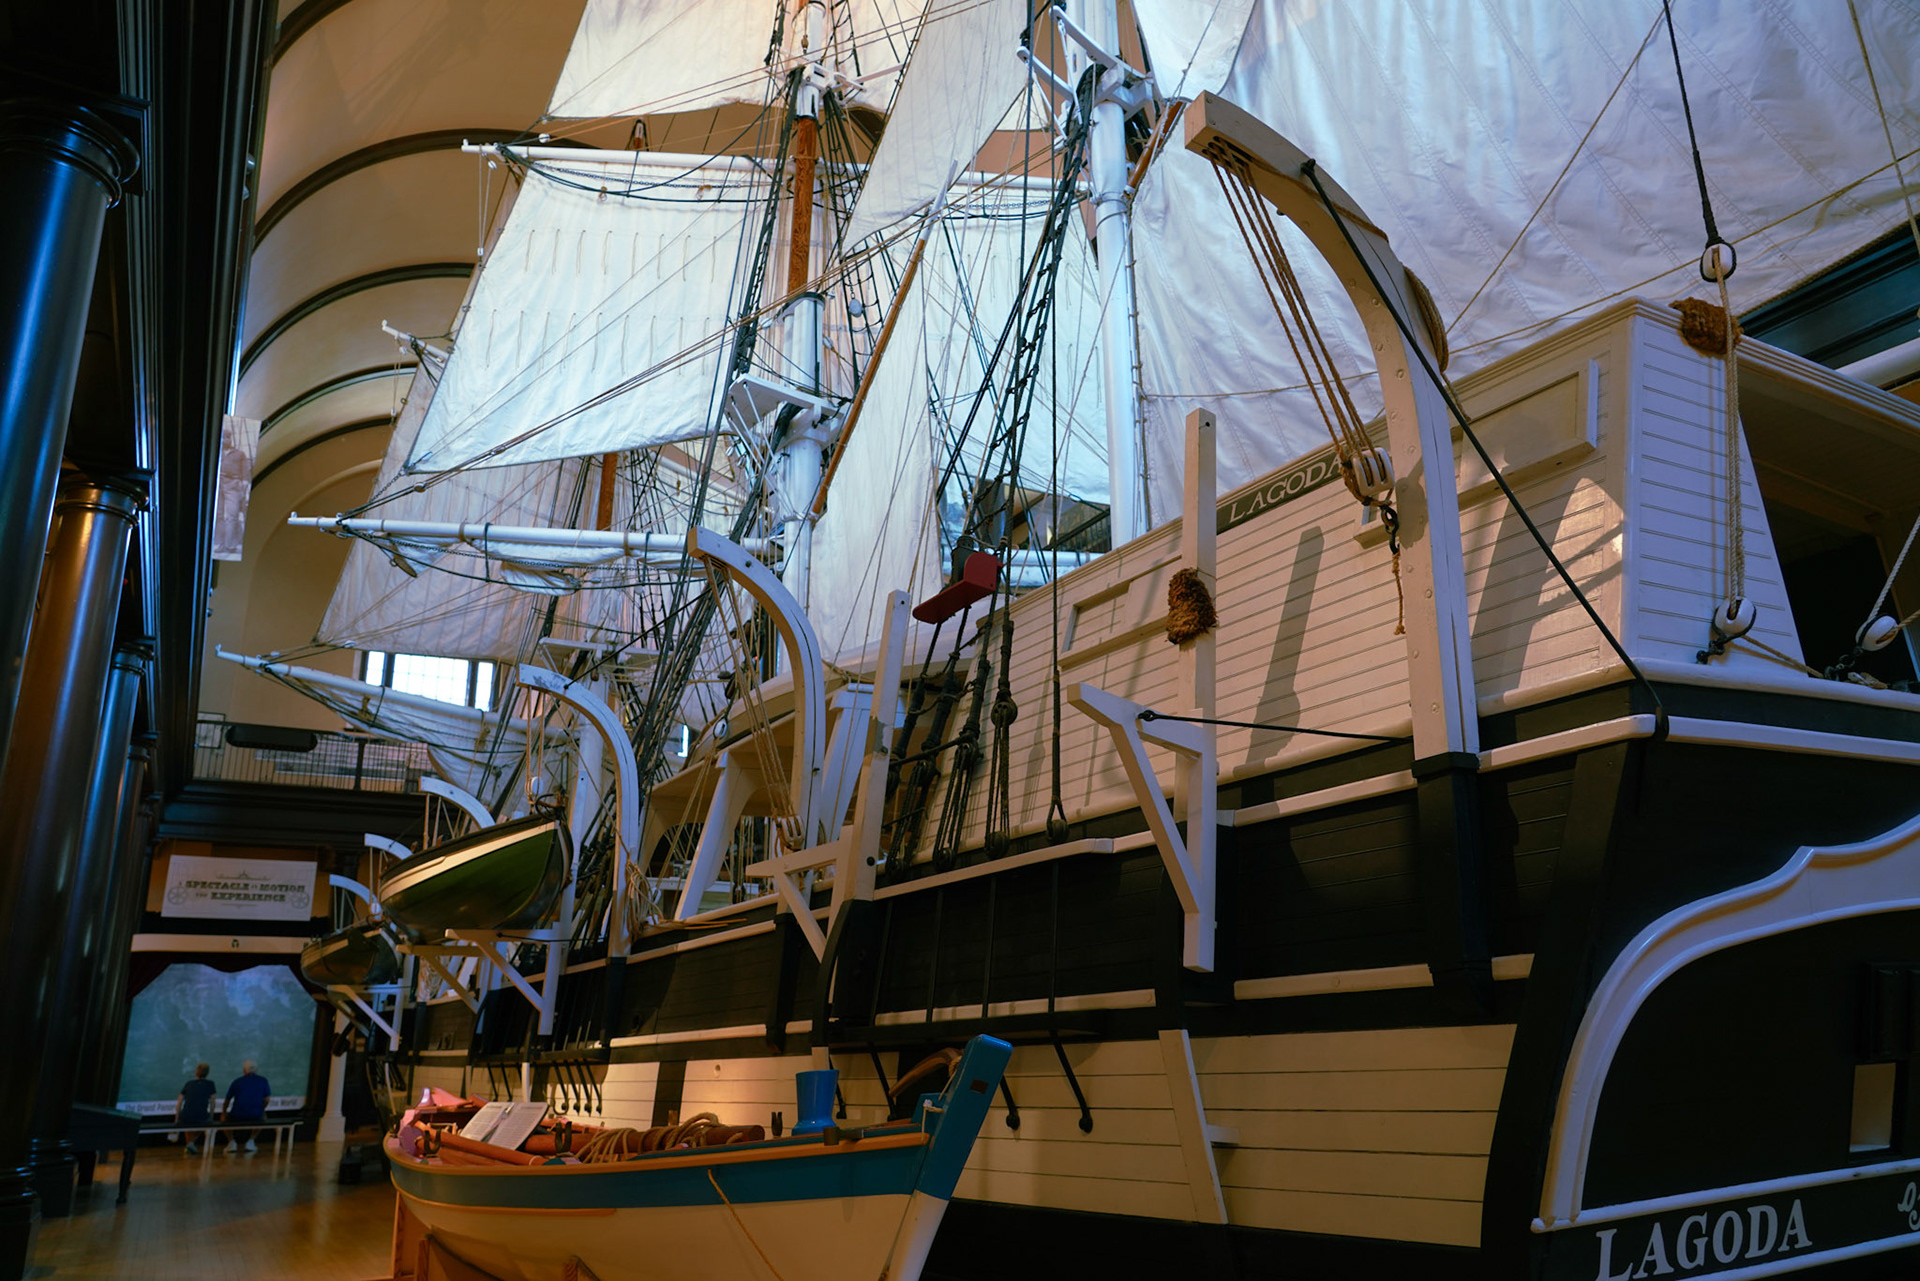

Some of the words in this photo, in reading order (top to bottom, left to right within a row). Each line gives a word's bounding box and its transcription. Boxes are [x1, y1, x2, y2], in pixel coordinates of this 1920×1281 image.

[1229, 455, 1342, 524] LAGODA
[185, 880, 250, 890] SPECTACLE
[259, 883, 305, 893] MOTION
[211, 892, 286, 902] EXPERIENCE
[1595, 1198, 1813, 1281] LAGODA
